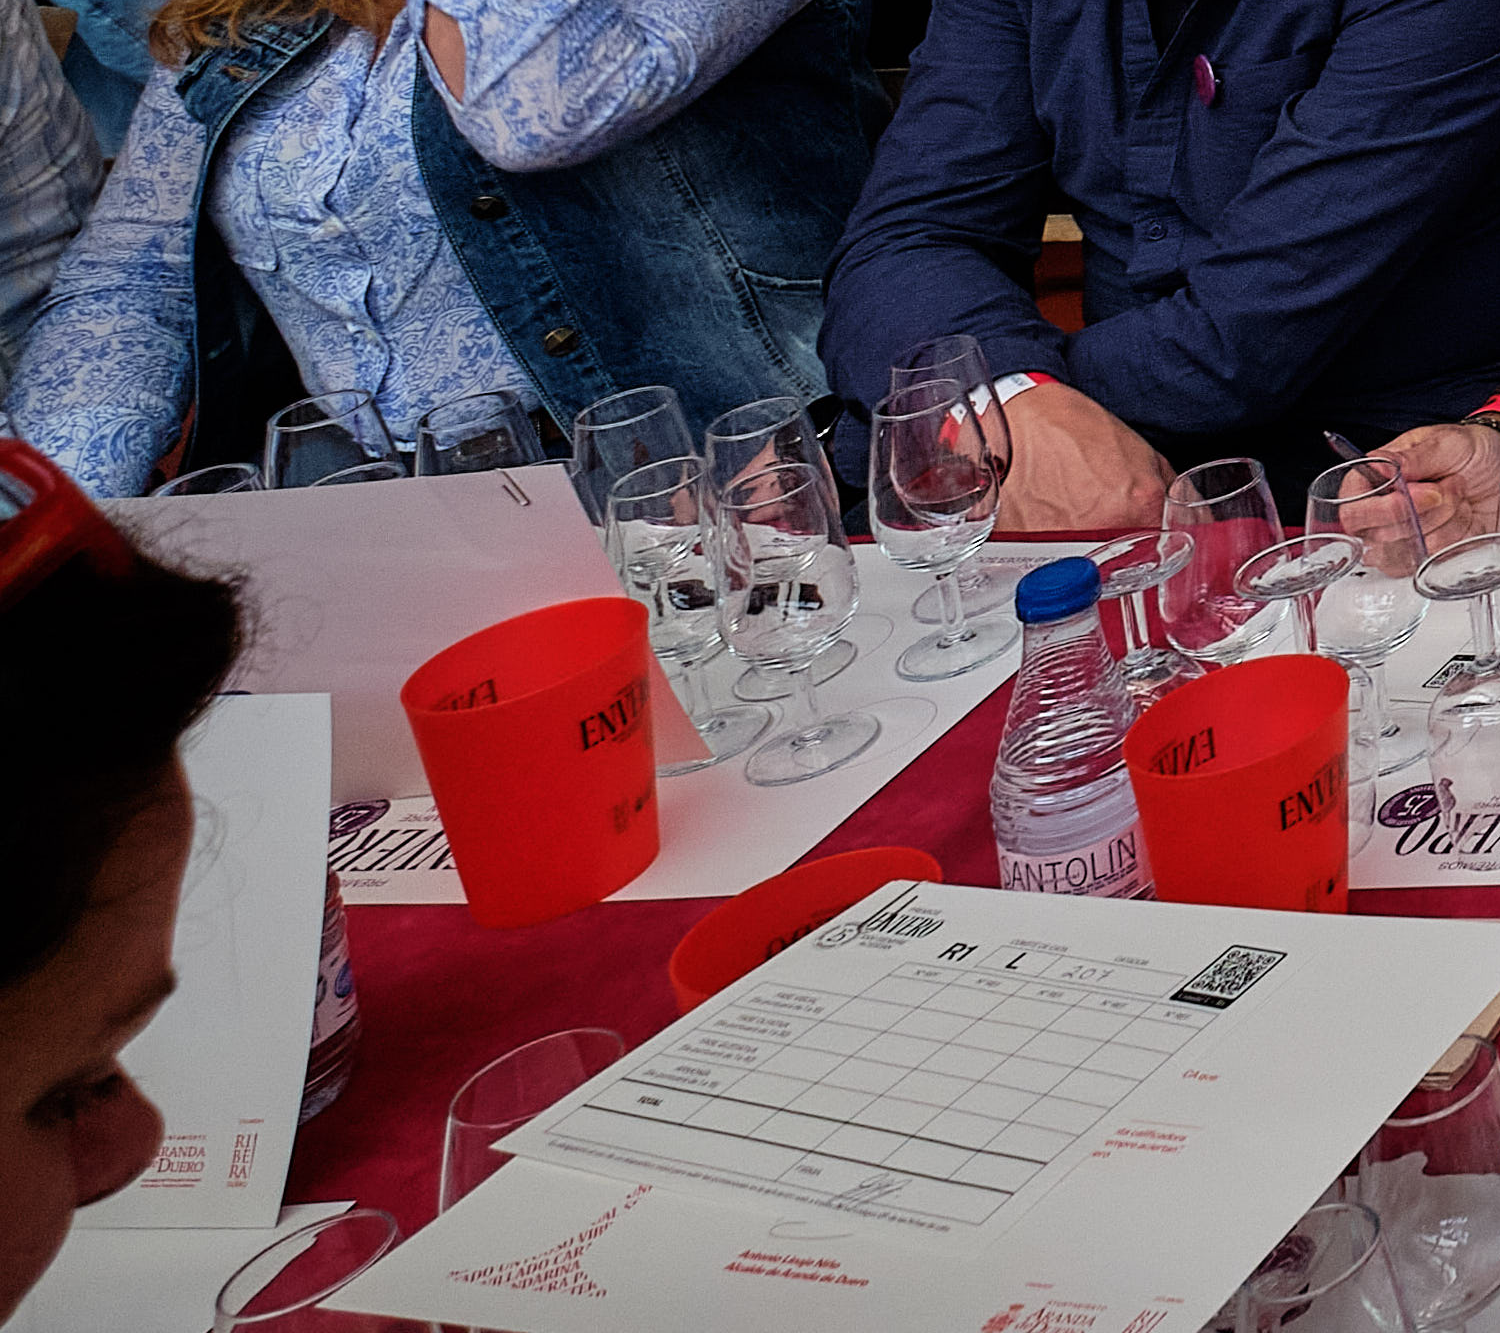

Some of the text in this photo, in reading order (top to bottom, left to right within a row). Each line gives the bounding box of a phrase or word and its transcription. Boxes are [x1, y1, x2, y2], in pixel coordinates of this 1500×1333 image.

[1403, 793, 1440, 818] 25
[934, 942, 982, 961] R1
[1001, 952, 1036, 970] L
